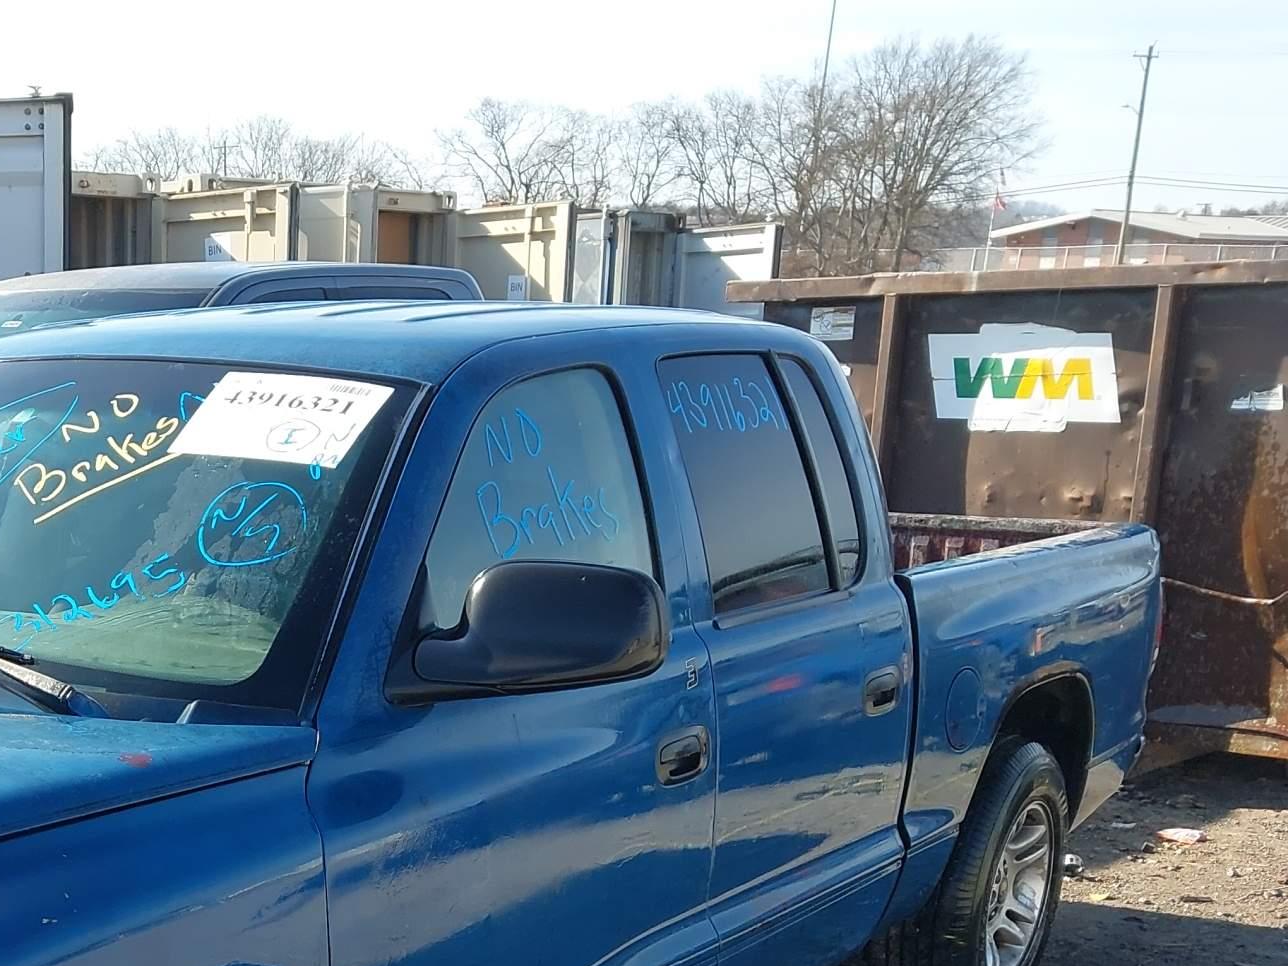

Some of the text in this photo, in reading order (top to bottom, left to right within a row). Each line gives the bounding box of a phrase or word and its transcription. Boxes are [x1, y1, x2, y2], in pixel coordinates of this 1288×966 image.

[208, 244, 222, 256] BIN
[224, 388, 355, 415] 43916321
[952, 356, 1096, 400] WM
[62, 394, 140, 442] NO
[667, 376, 789, 433] 43916321
[14, 416, 179, 505] Brakes
[485, 408, 541, 468] NO
[477, 466, 620, 560] Brakes
